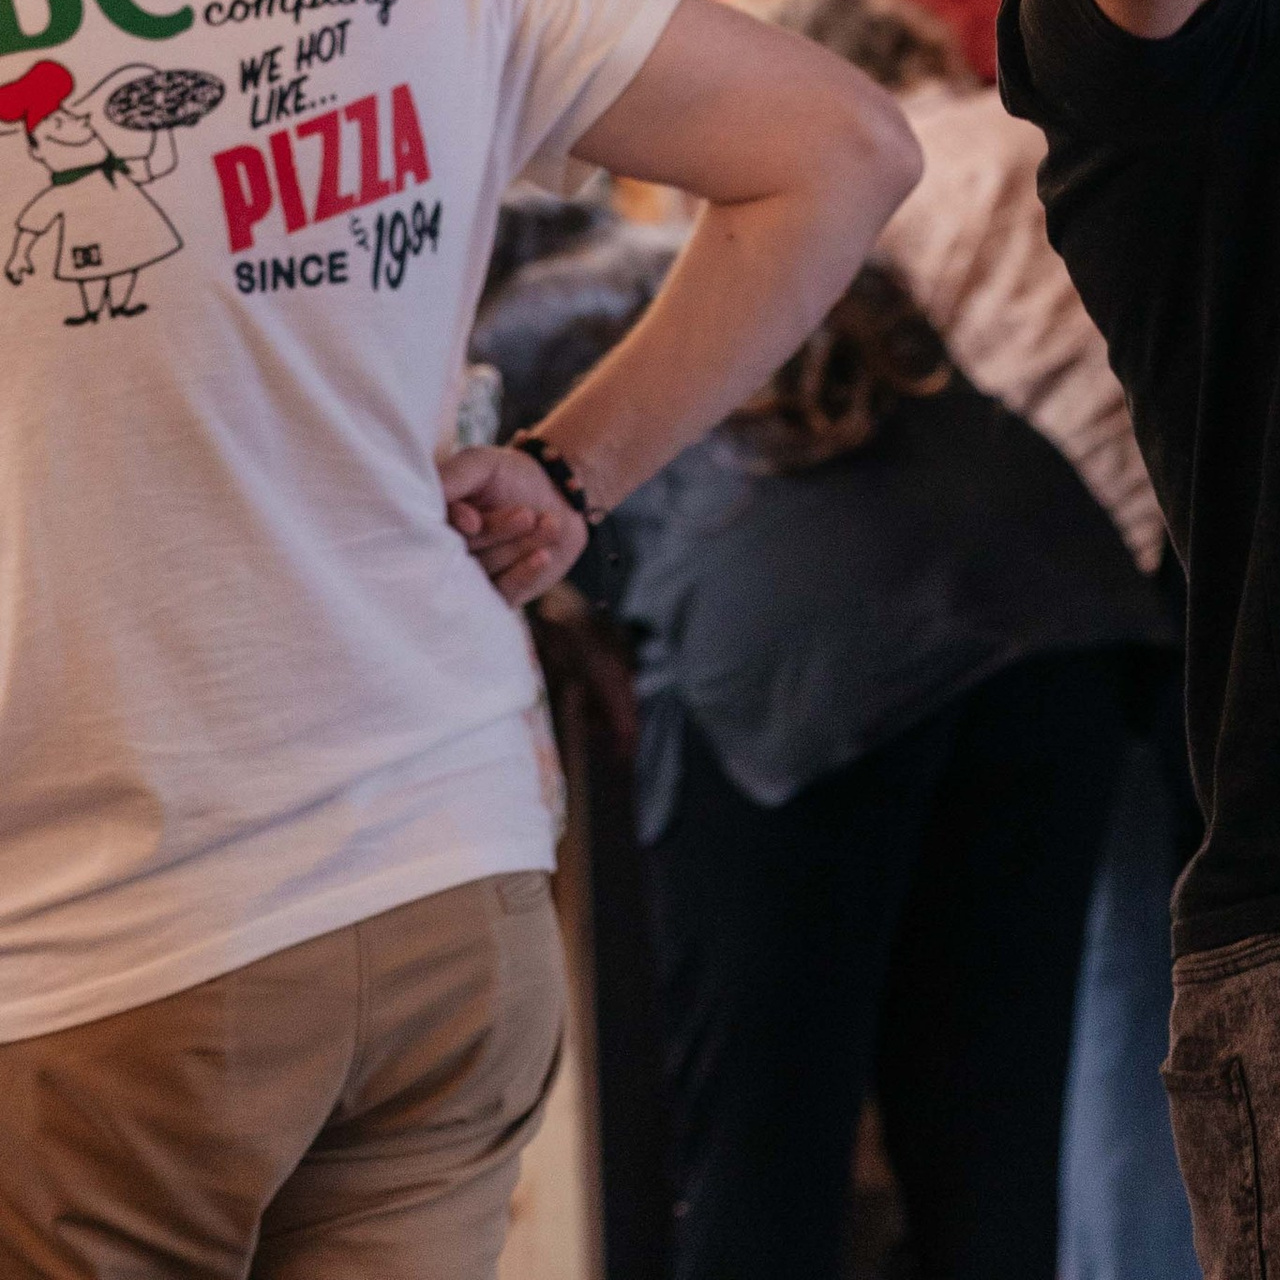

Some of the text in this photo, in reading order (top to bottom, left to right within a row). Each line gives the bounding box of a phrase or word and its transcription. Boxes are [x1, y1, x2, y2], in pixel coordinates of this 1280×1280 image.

[240, 18, 352, 94] WE HOT
[213, 81, 432, 255] PIZZA
[235, 251, 349, 295] SINCE
[371, 199, 444, 292] 1994
